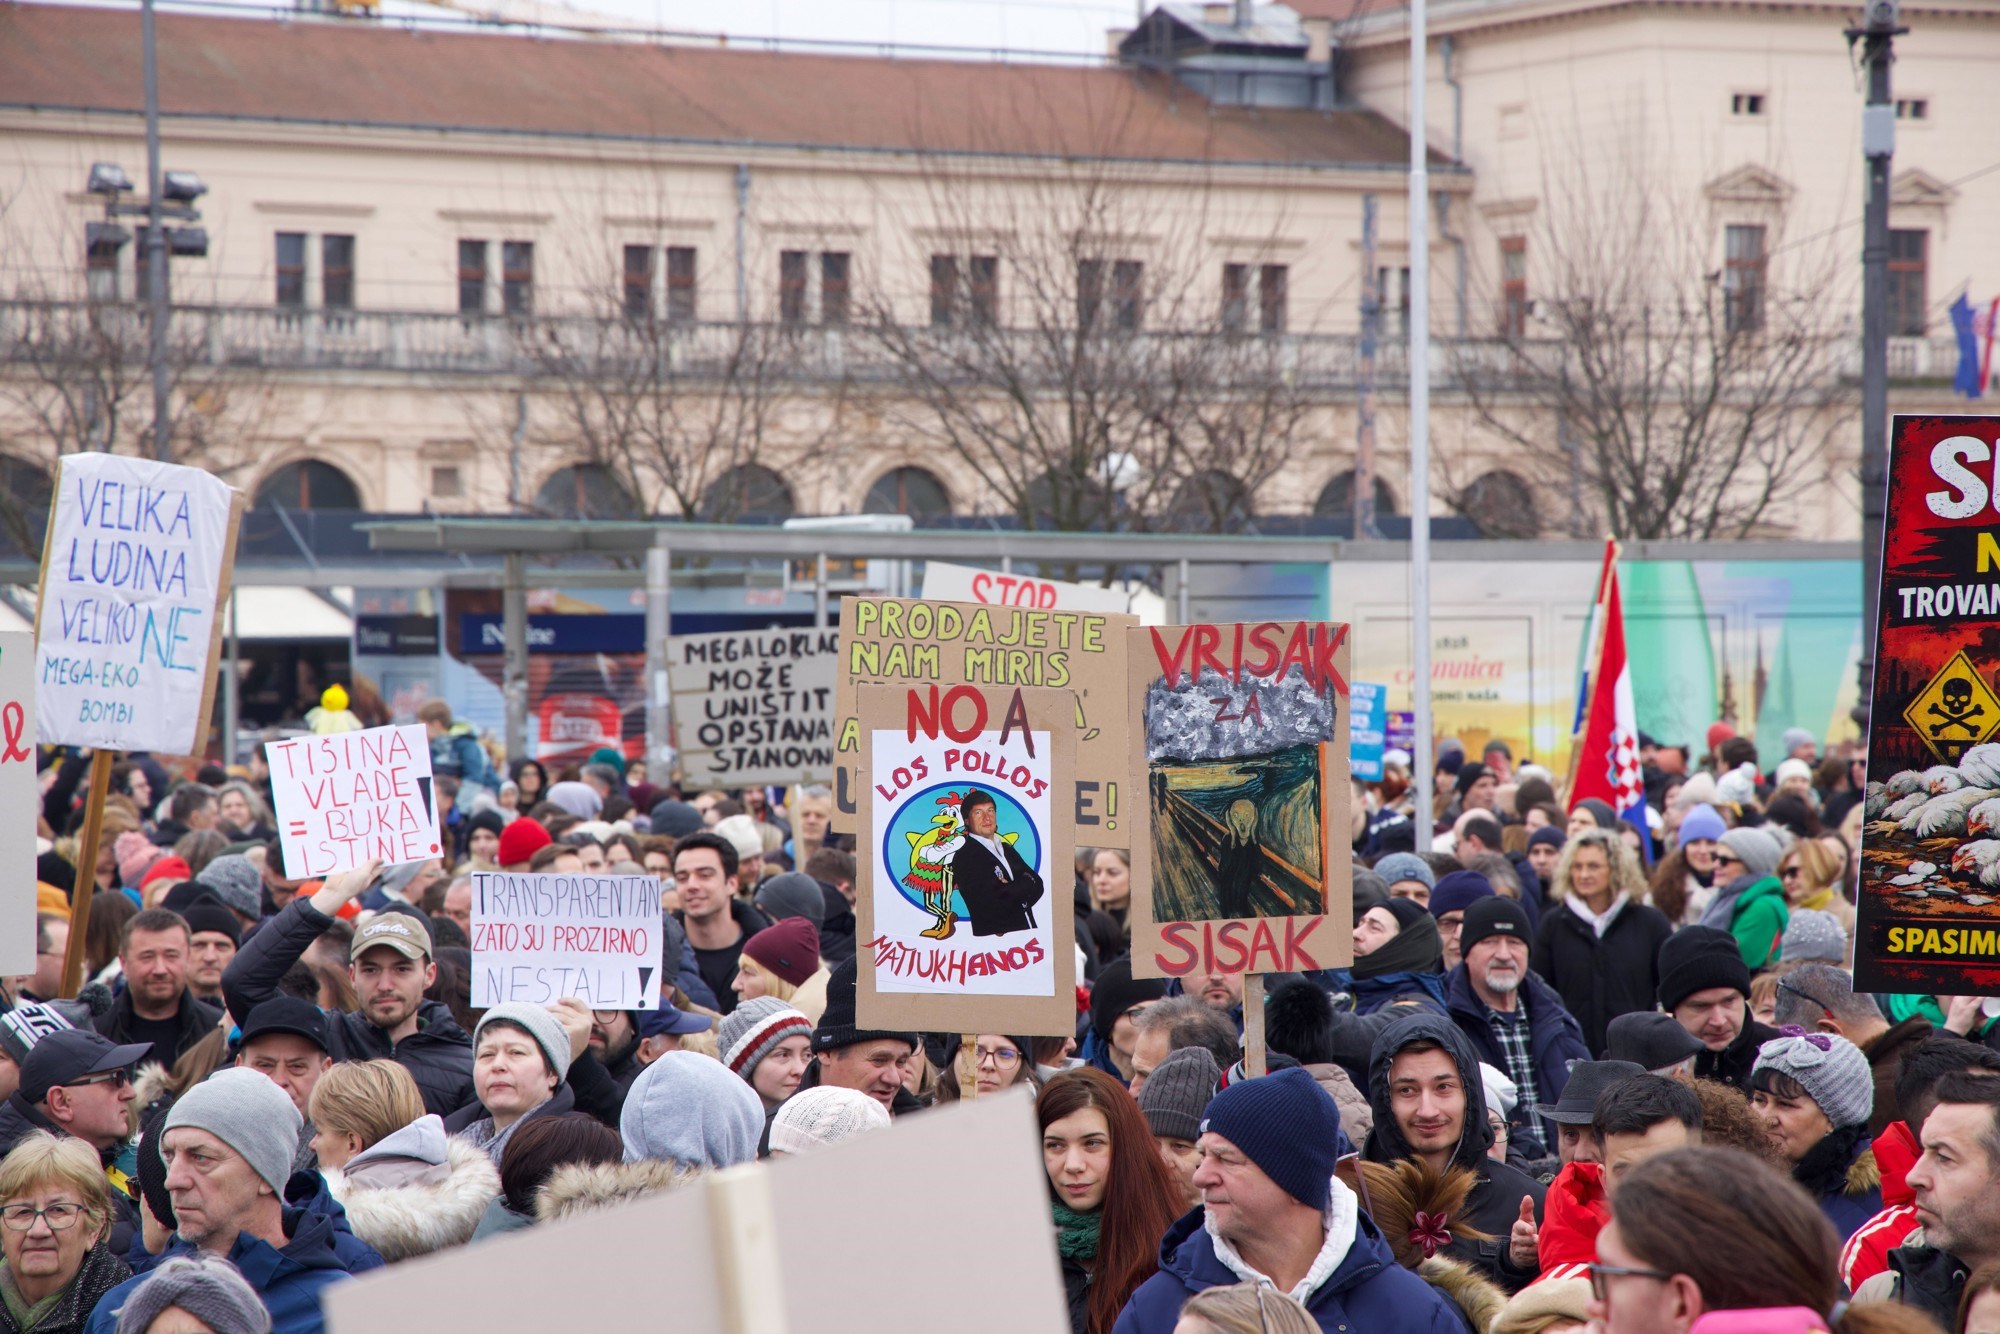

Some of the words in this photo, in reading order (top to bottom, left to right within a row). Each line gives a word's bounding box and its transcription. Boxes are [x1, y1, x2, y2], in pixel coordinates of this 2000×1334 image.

[1925, 435, 2000, 519] S
[79, 478, 192, 539] VELIKA
[68, 537, 187, 597] LUDINA
[60, 598, 137, 645] VELIKO
[140, 606, 202, 672] NE
[856, 601, 1105, 652] PRODAJETE
[709, 661, 792, 691] MOŽE
[851, 641, 940, 679] NAM
[965, 648, 1070, 688] MIRIS
[1149, 621, 1350, 698] VRISAK
[79, 699, 133, 724] BOMBI
[698, 718, 834, 746] OPSTANA
[907, 684, 988, 744] NO
[999, 687, 1035, 759] A
[1210, 690, 1263, 728] ZA
[277, 731, 411, 778] TIŠINA
[875, 755, 928, 801] LOS
[944, 749, 1049, 800] POLLOS
[301, 766, 411, 809] VLADE
[325, 800, 418, 840] BUKA
[473, 874, 659, 918] TRANSPARENTAN
[473, 923, 518, 951] ZATO
[522, 924, 544, 951] SU
[553, 926, 647, 956] PROZIRNO
[1155, 916, 1324, 976] SISAK
[1887, 927, 2000, 955] SPASIM
